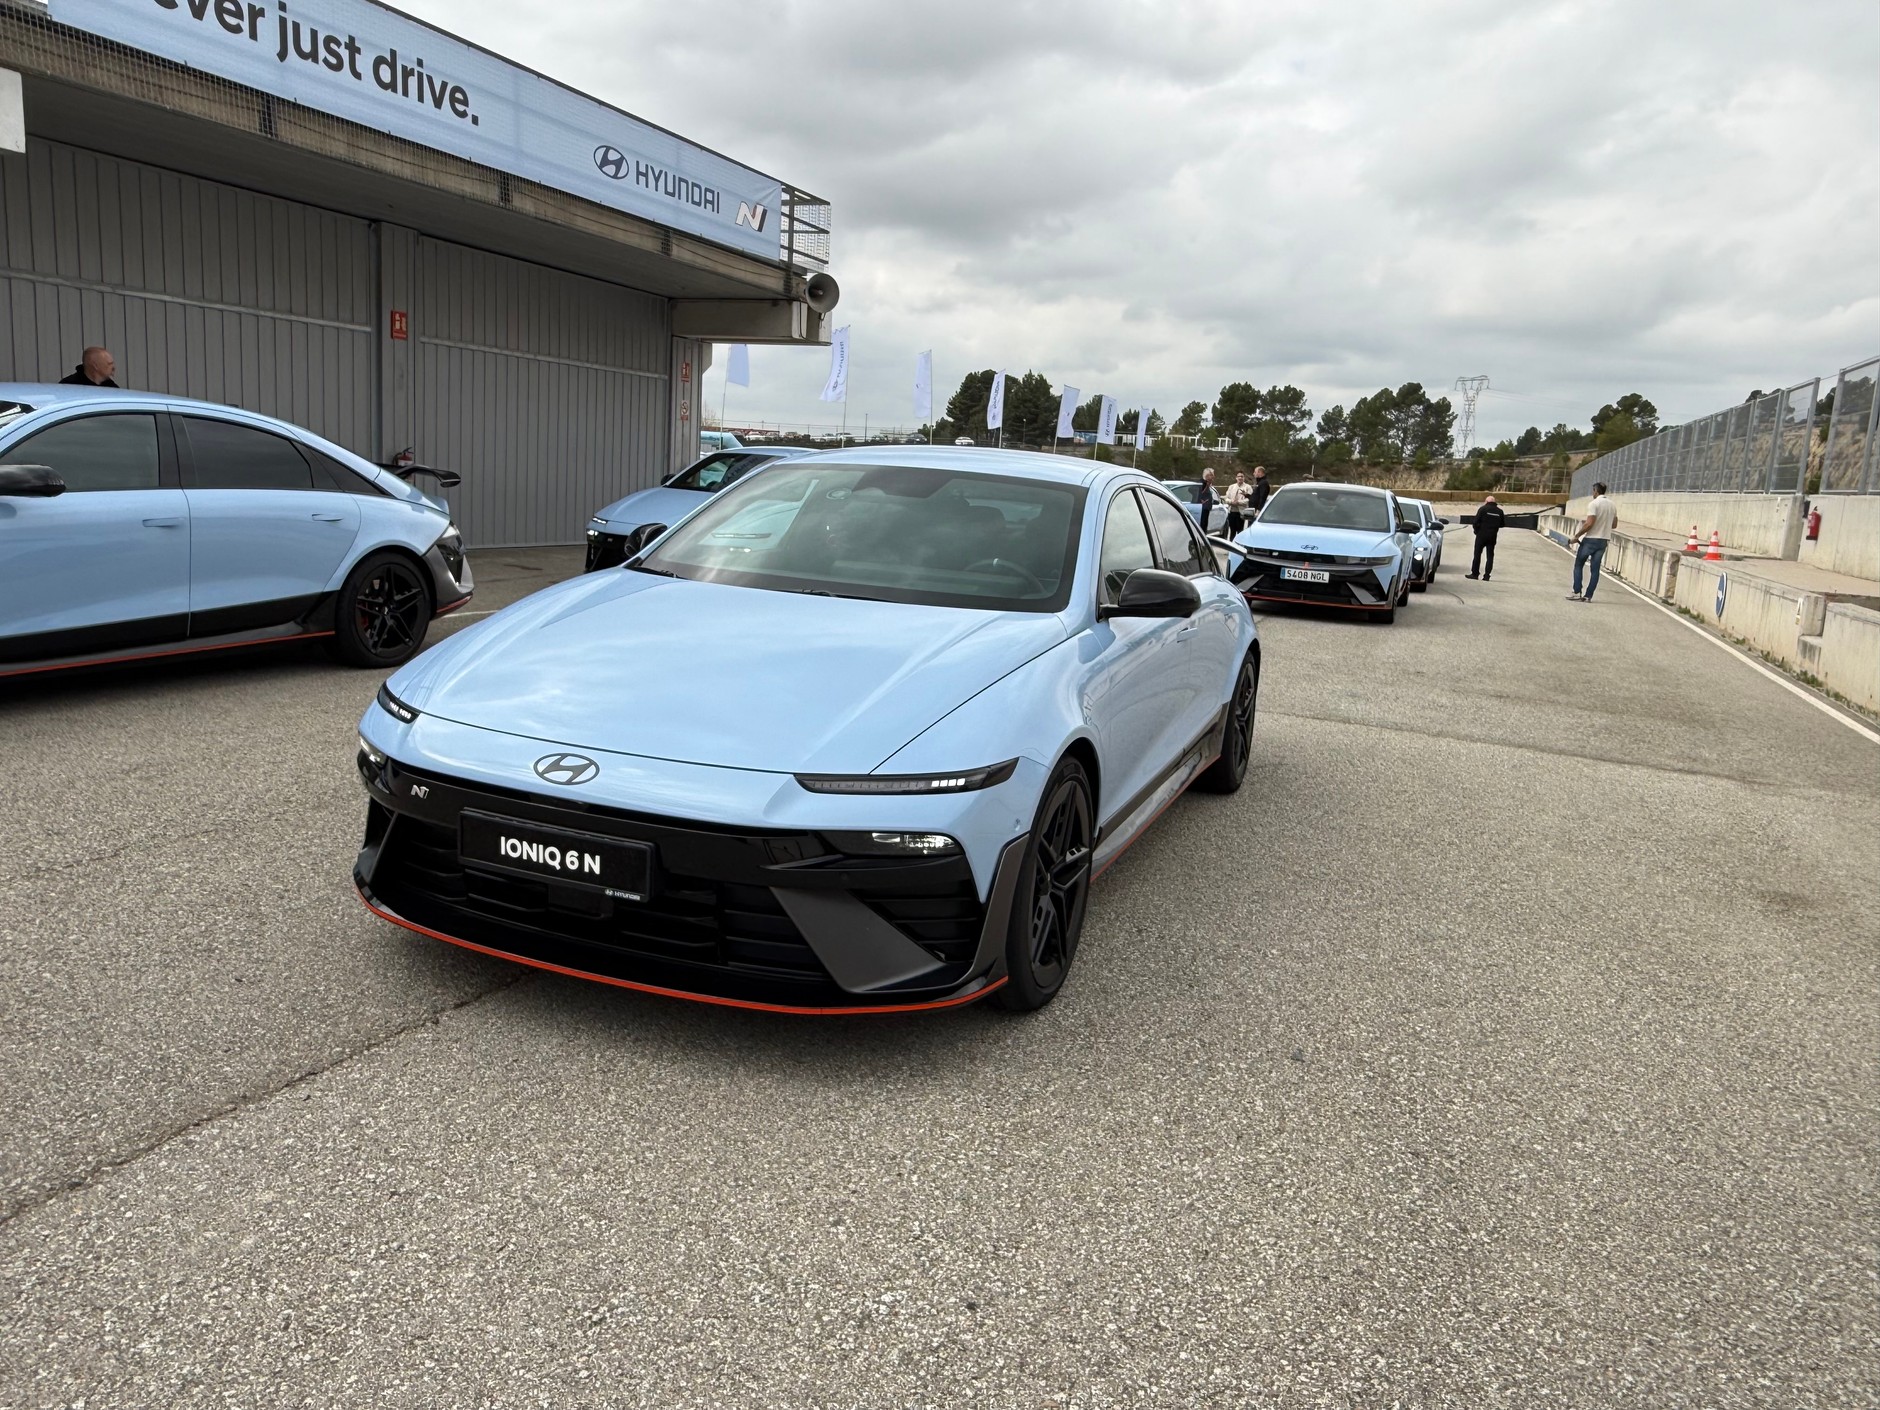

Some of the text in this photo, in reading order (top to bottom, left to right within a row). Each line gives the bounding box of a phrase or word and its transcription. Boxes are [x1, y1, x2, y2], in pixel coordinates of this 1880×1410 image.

[154, 0, 479, 126] ver just drive.
[635, 160, 720, 214] HYUNDAI
[735, 200, 768, 233] N
[500, 836, 600, 875] IONIQ 6 N
